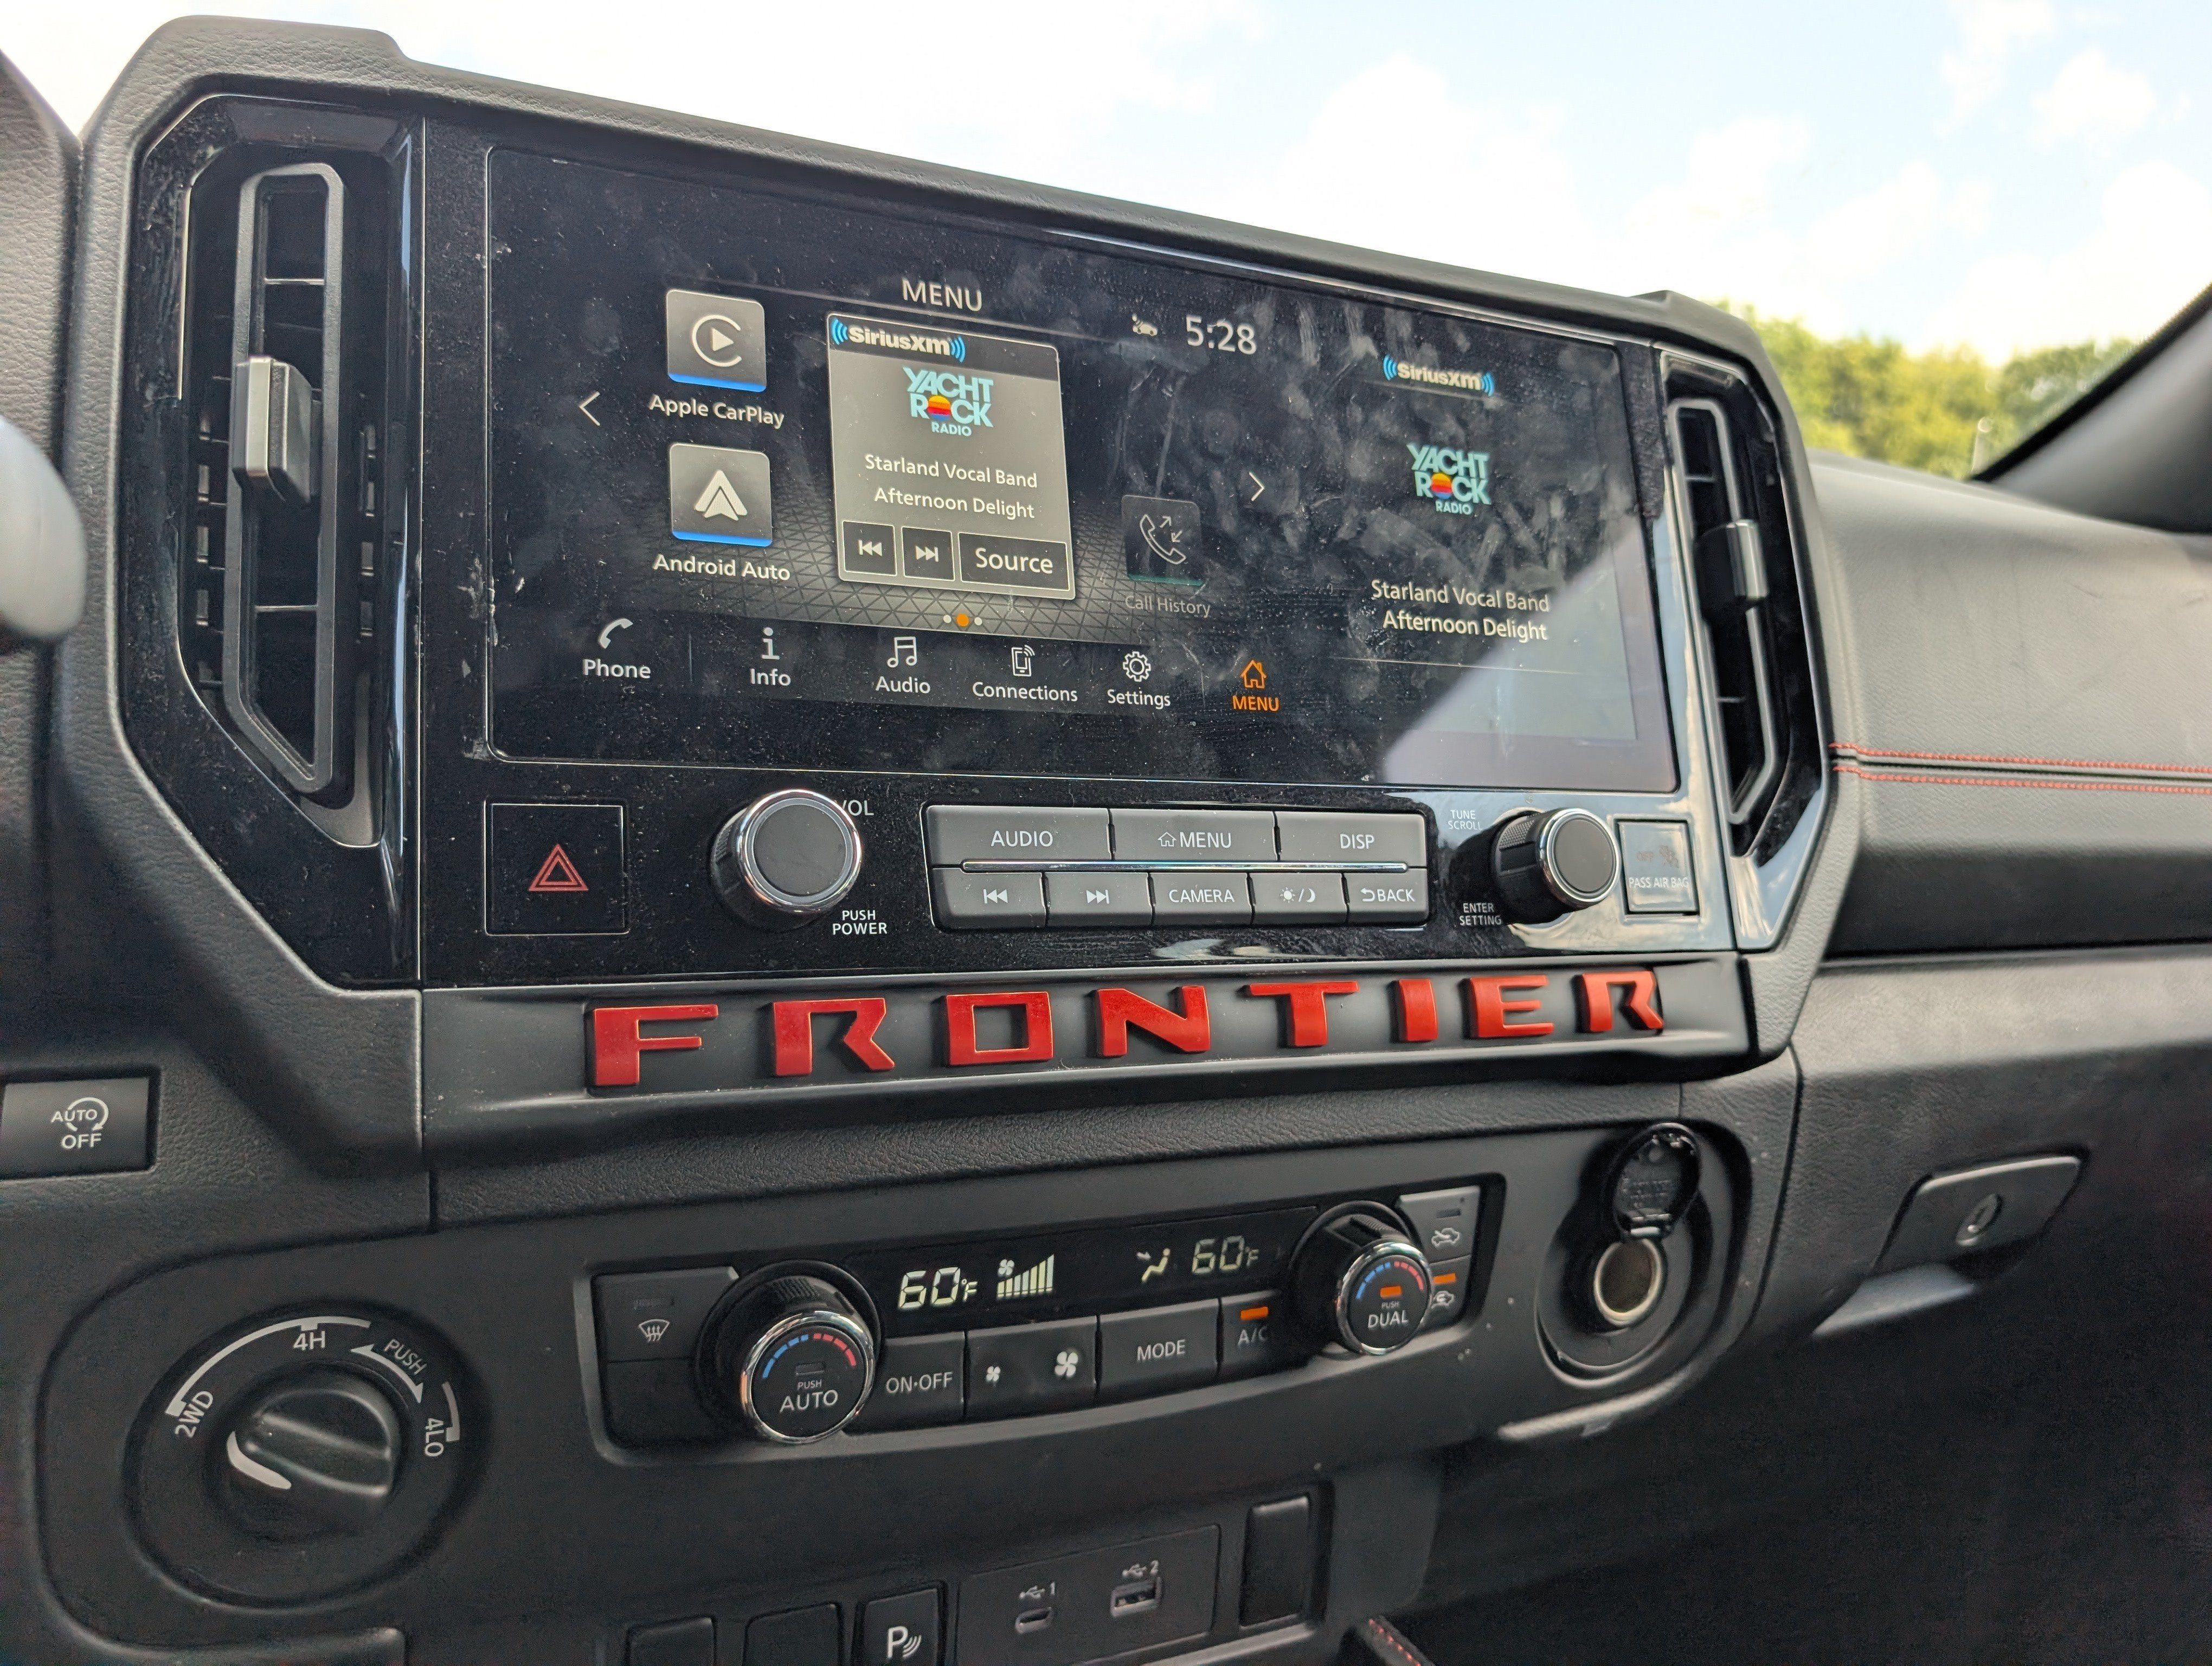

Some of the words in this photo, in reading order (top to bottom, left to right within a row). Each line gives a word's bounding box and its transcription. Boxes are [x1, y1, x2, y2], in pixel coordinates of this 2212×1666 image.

[902, 278, 983, 312] MENU
[1185, 315, 1258, 355] 5:28
[902, 365, 994, 402] YACHT
[648, 394, 709, 418] Apple
[713, 402, 785, 431] CarPlay
[910, 392, 994, 428] ROCK
[931, 421, 973, 438] RADIO
[864, 453, 940, 478] Starland
[943, 463, 991, 484] Vocal
[995, 469, 1038, 489] Band
[1407, 443, 1490, 478] YACHT
[1416, 470, 1491, 505] ROCK
[873, 487, 968, 511] Afternoon
[972, 497, 1036, 522] Delight
[1435, 498, 1473, 515] RADIO
[652, 553, 737, 578] Android
[740, 561, 791, 581] Auto
[975, 547, 1053, 575] Source
[1124, 594, 1154, 613] Call
[1157, 597, 1211, 618] History
[1371, 578, 1449, 604] Starland
[1452, 587, 1501, 608] Vocal
[1506, 591, 1550, 613] Band
[1382, 608, 1479, 636] Afternoon
[1483, 617, 1548, 644] Delight
[582, 658, 652, 680] Phone
[749, 667, 792, 687] Info
[875, 675, 931, 694] Audio
[972, 681, 1078, 703] Connections
[1107, 688, 1172, 710] Settings
[1231, 695, 1280, 712] MENU
[1447, 819, 1483, 831] SCROLL
[1450, 809, 1477, 821] TUNE
[991, 830, 1054, 848] AUDIO
[1179, 830, 1232, 849] MENU
[1340, 834, 1375, 850] DISP
[1628, 876, 1651, 889] PASS
[1653, 876, 1669, 888] AIR
[1670, 876, 1689, 888] BAG
[1168, 888, 1236, 904] CAMERA
[1378, 888, 1416, 902] BACK
[841, 909, 876, 921] PUSH
[1462, 902, 1495, 914] ENTER
[832, 922, 888, 935] POWER
[1458, 914, 1502, 926] SETTING
[592, 970, 1664, 1087] FRONTIER
[50, 1108, 98, 1123] AUTO
[61, 1132, 102, 1150] OFF
[1381, 1300, 1400, 1310] PUSH
[1367, 1310, 1409, 1329] DUAL
[293, 1330, 326, 1351] 4H
[1237, 1325, 1269, 1348] A/C
[383, 1338, 427, 1375] PUSH
[1136, 1338, 1187, 1362] MODE
[796, 1379, 823, 1391] PUSH
[779, 1389, 839, 1413] AUTO
[174, 1389, 214, 1439] 2WD
[423, 1417, 445, 1458] 4LO
